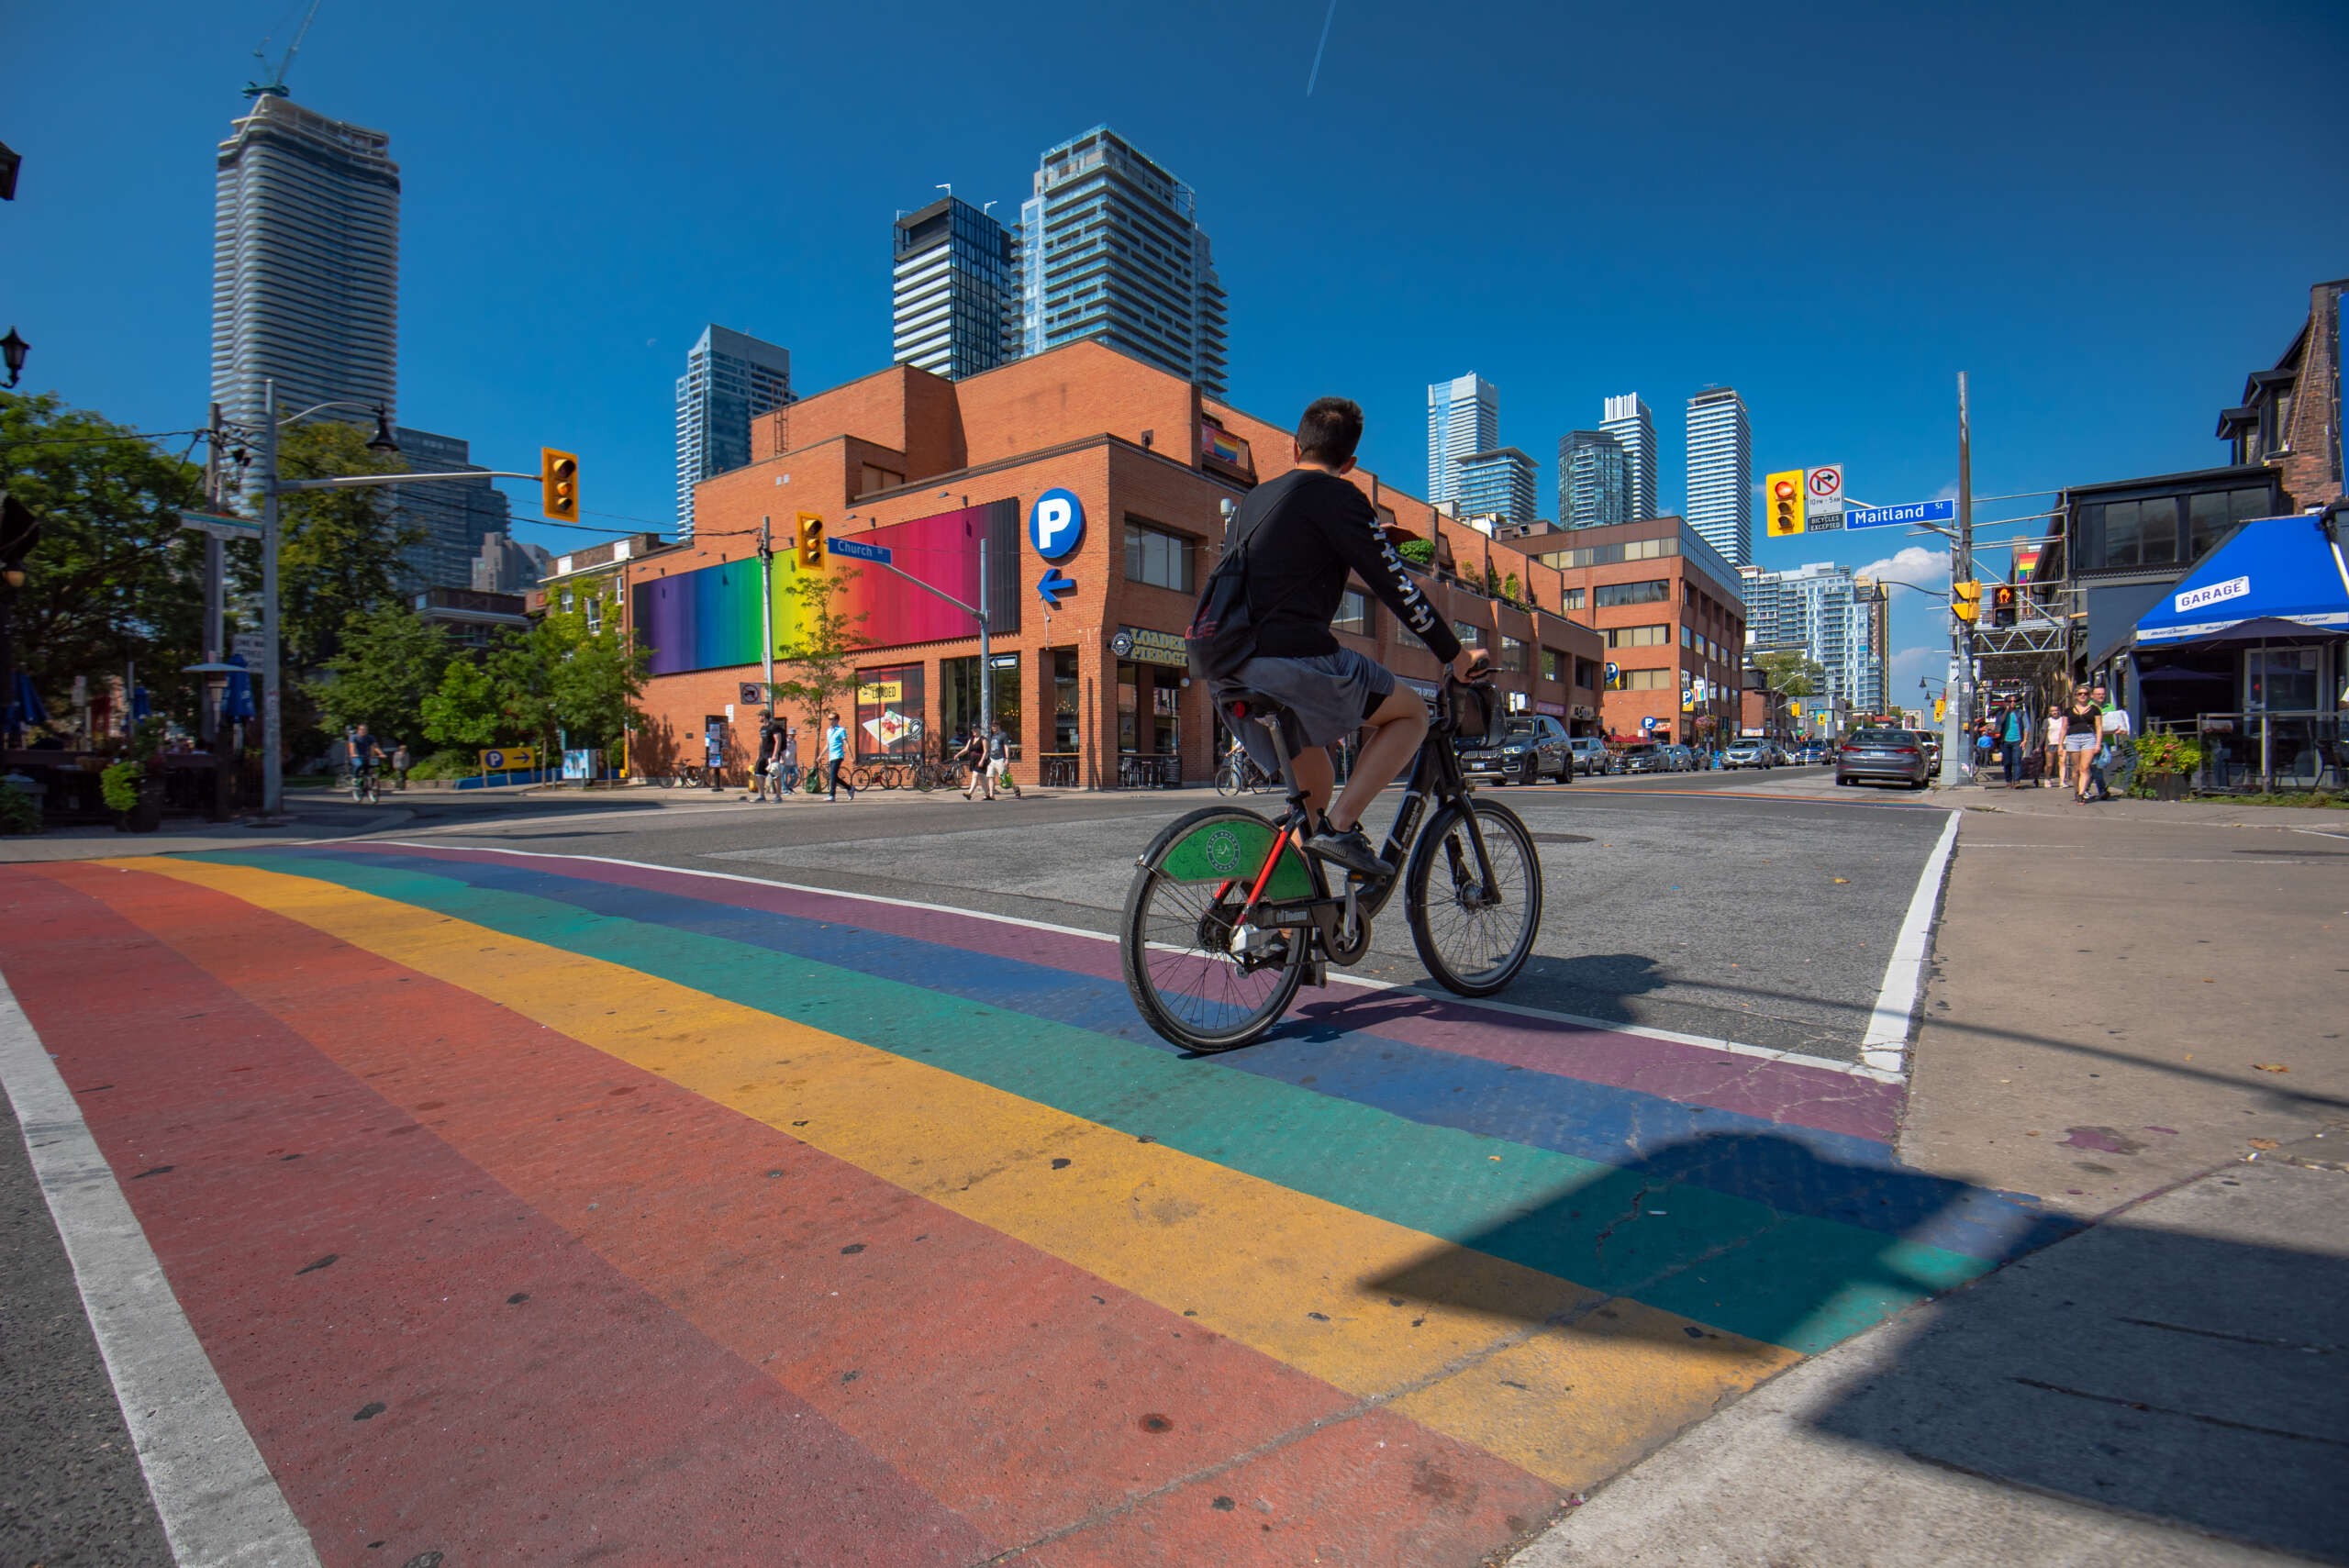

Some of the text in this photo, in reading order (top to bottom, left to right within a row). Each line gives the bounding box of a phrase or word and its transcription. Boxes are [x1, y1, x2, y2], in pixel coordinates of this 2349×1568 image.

[1811, 515, 1840, 524] BICYCLES
[1855, 505, 1924, 524] Maitland
[1038, 498, 1072, 549] P
[1810, 522, 1841, 531] EXCEPTED
[838, 540, 873, 557] Church
[2181, 583, 2242, 606] GARAGE
[1130, 628, 1186, 651] LOADED
[1130, 645, 1188, 667] PIEROGI
[1682, 690, 1691, 703] P
[1644, 717, 1653, 728] P
[489, 752, 501, 766] P
